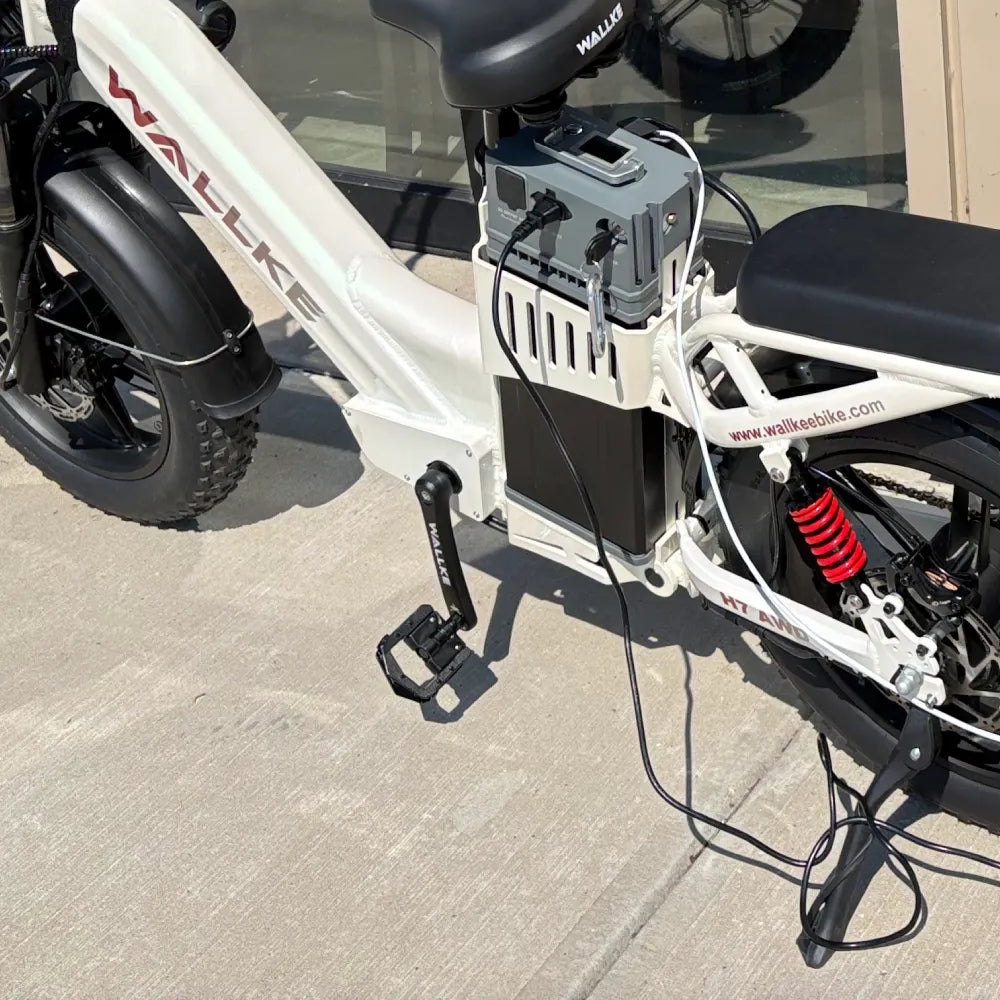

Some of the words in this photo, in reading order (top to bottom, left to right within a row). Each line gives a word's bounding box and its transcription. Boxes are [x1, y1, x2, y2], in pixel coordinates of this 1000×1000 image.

[576, 2, 624, 56] WALLKE
[109, 64, 326, 322] WALLKE
[728, 399, 886, 442] www.wallkeebike.com
[429, 523, 451, 587] WALLKE
[758, 610, 810, 643] AWD
